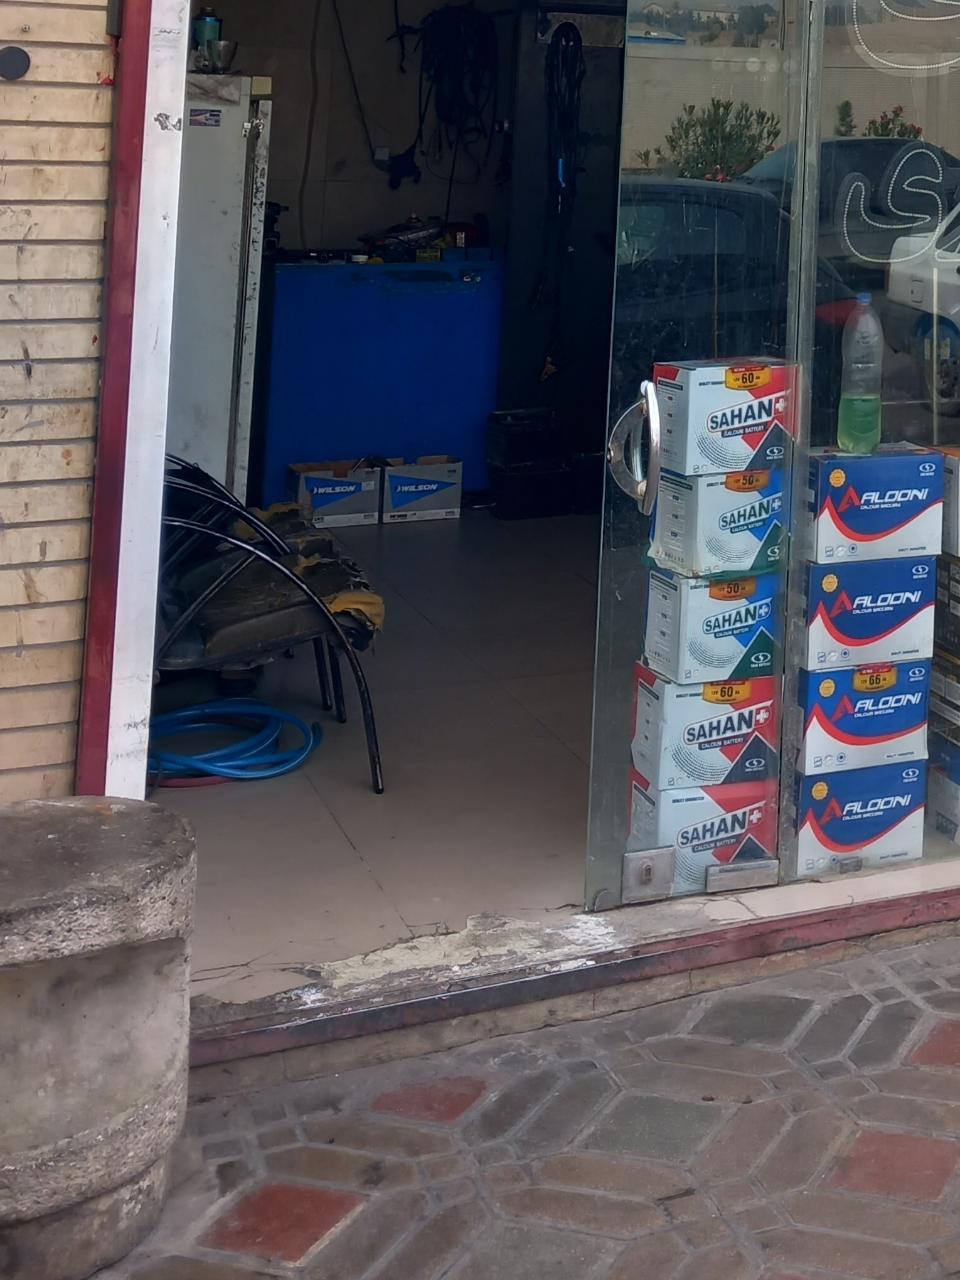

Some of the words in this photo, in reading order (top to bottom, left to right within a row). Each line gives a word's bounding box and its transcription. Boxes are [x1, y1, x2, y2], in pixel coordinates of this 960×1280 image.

[741, 372, 754, 385] 60
[741, 474, 754, 486] 50
[318, 485, 356, 494] WILSON
[401, 483, 438, 492] WILSON
[726, 582, 740, 594] 50
[868, 674, 881, 686] 66
[719, 686, 734, 698] 60
